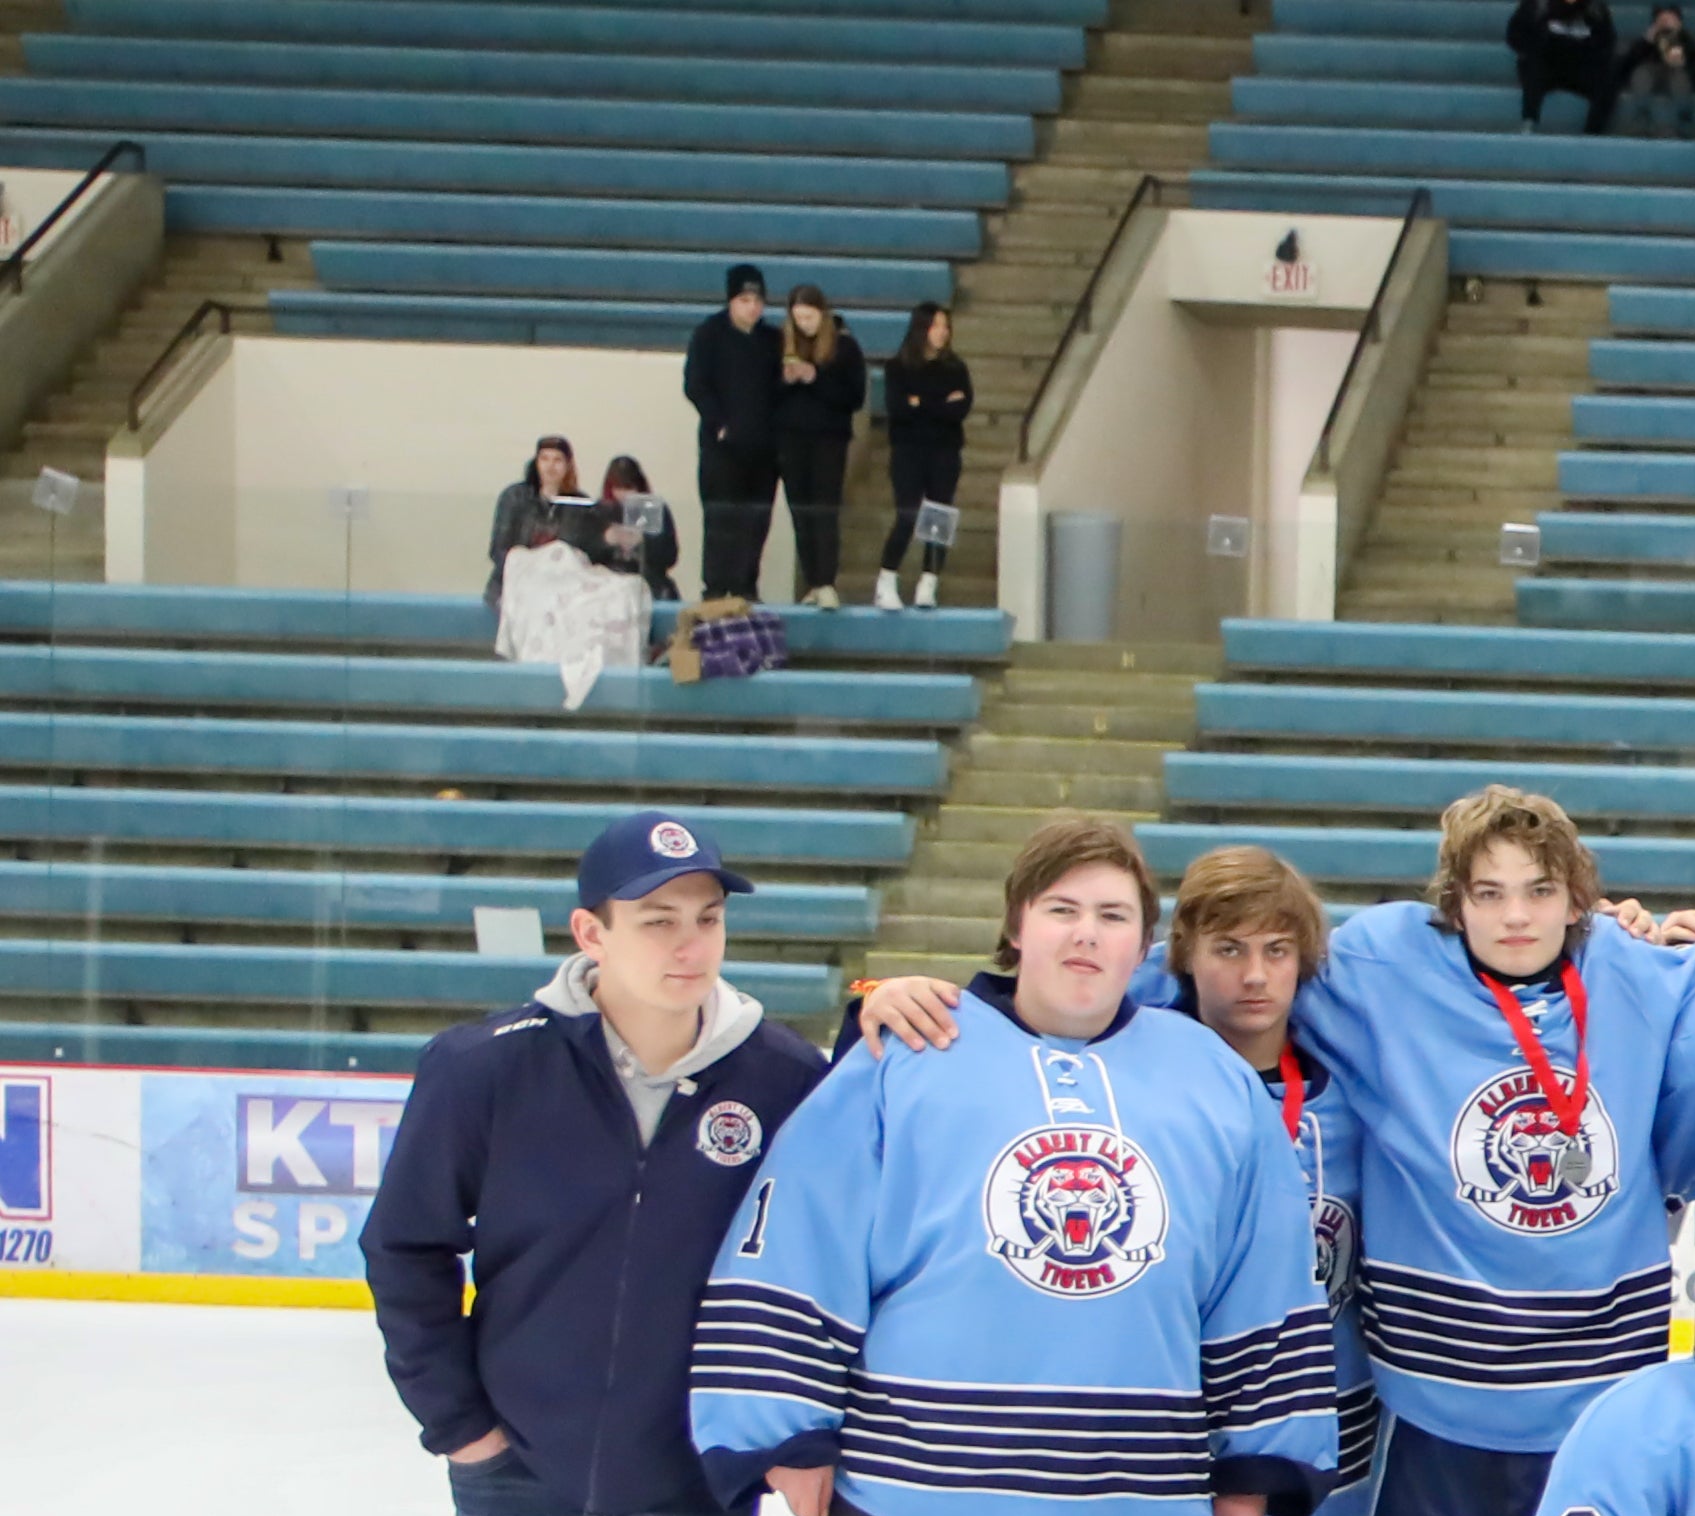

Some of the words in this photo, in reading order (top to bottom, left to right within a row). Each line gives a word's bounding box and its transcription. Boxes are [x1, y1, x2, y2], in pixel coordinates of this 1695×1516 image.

[1271, 264, 1309, 291] EXIT
[1014, 1133, 1091, 1170] ALBERT
[737, 1178, 775, 1259] 1
[1508, 1202, 1578, 1229] TIGERS
[1038, 1262, 1116, 1290] TIGERS
